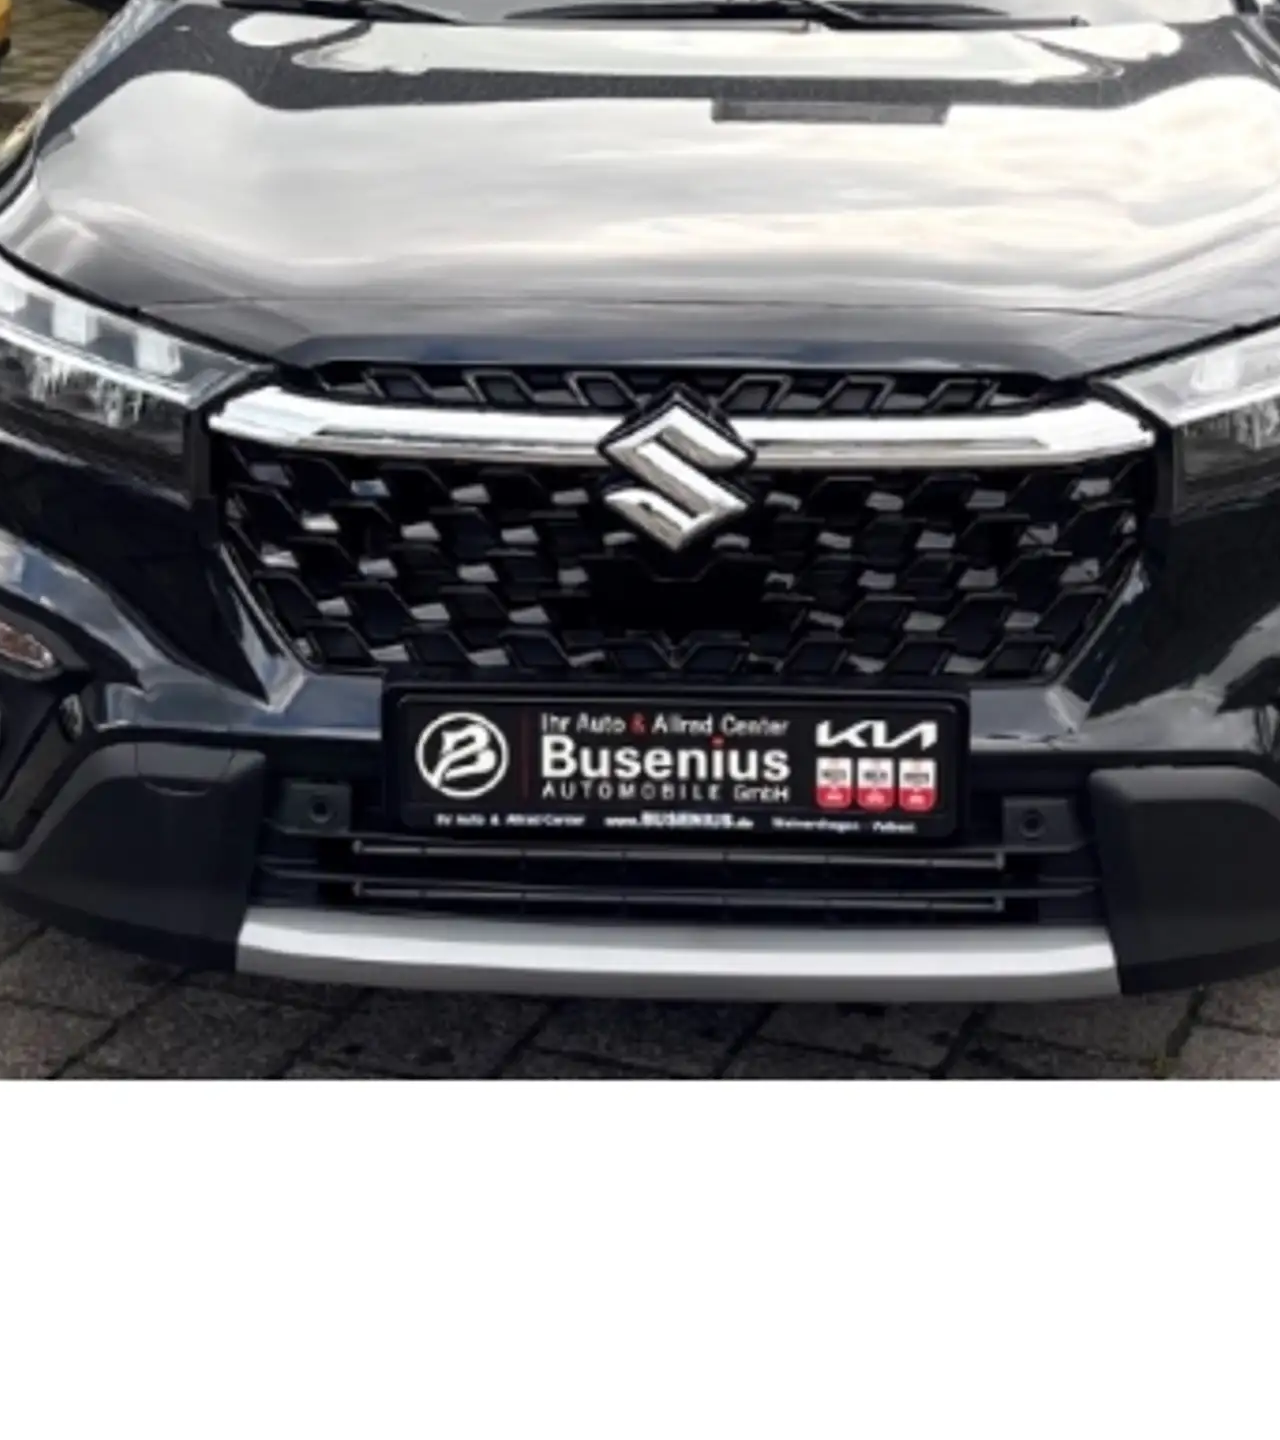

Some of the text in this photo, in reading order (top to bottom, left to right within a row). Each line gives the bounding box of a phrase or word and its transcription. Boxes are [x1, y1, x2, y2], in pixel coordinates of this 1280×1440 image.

[540, 712, 571, 733] Ihr
[576, 712, 627, 734] Auto
[720, 713, 791, 736] Center
[815, 719, 938, 750] KIA
[540, 733, 792, 780] Busenius
[541, 780, 790, 804] AUTOMOBILE GmbH
